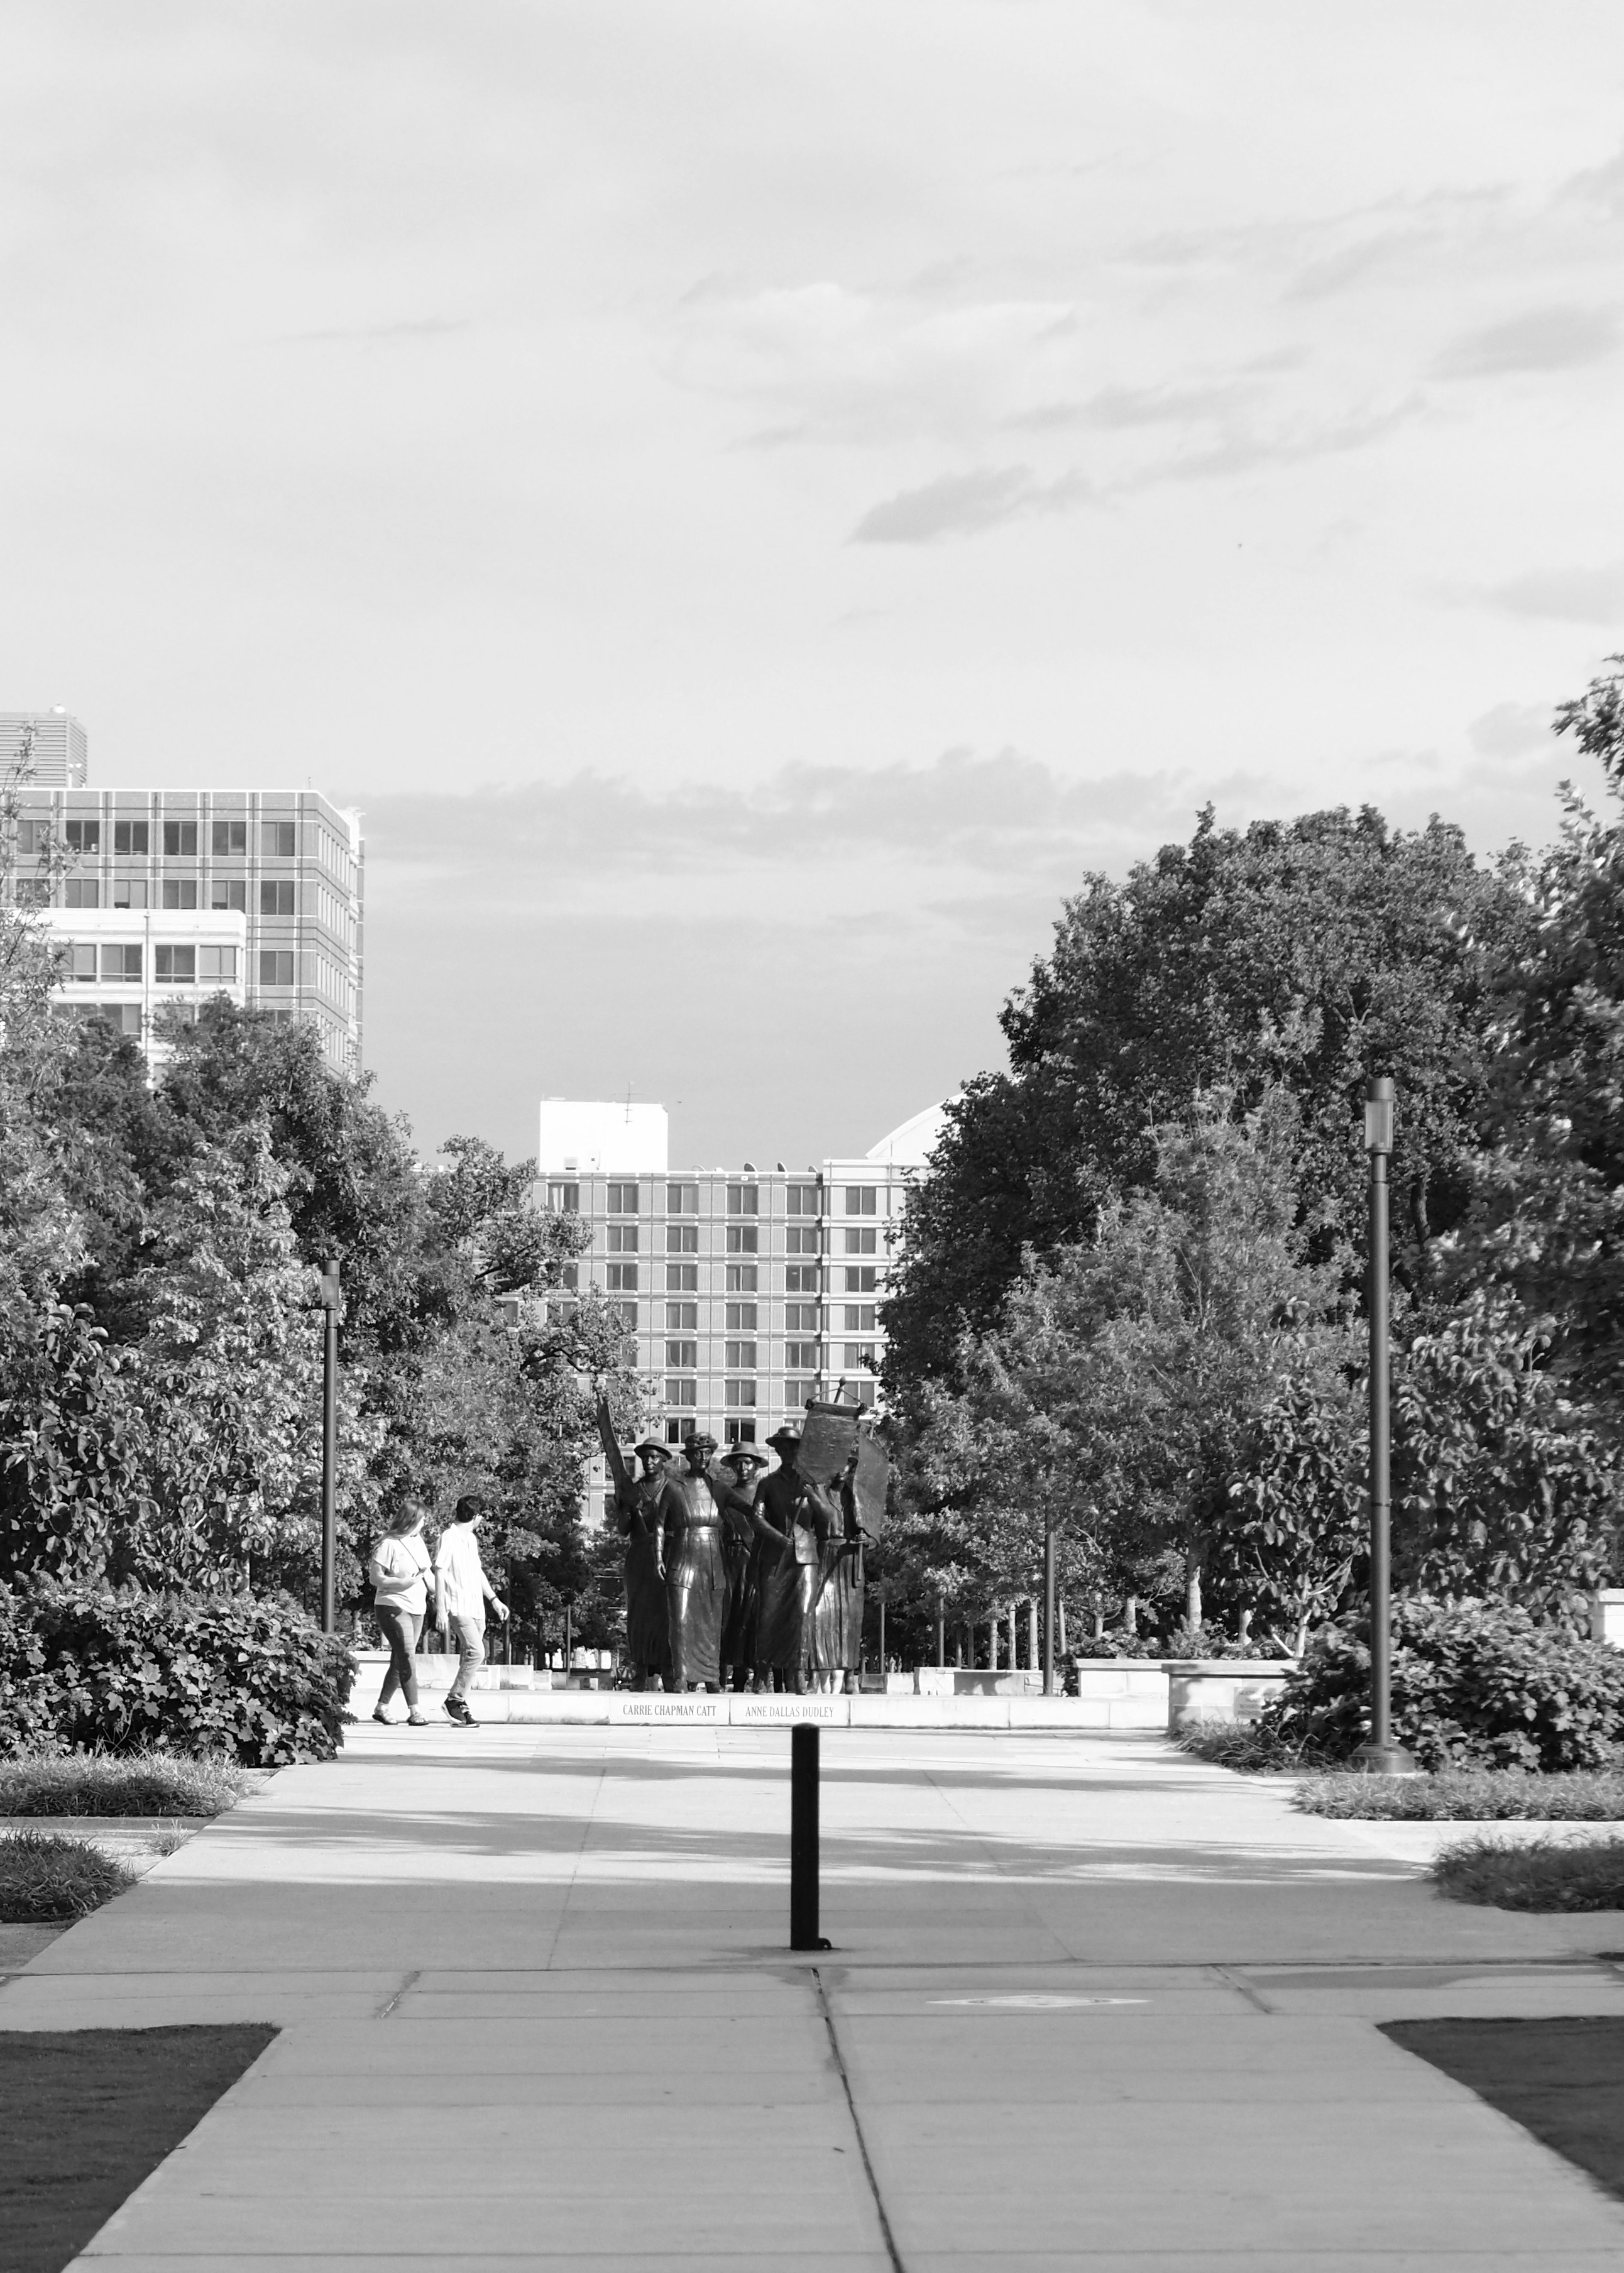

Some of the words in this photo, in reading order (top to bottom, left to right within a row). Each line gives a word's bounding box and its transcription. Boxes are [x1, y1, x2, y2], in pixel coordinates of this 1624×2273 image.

[623, 1704, 652, 1716] CARRIE
[654, 1705, 694, 1716] CHAPMAN
[696, 1706, 716, 1717] CATT
[745, 1706, 767, 1717] ANNE
[769, 1706, 800, 1717] DALLAS
[803, 1706, 834, 1718] DUDLEY
